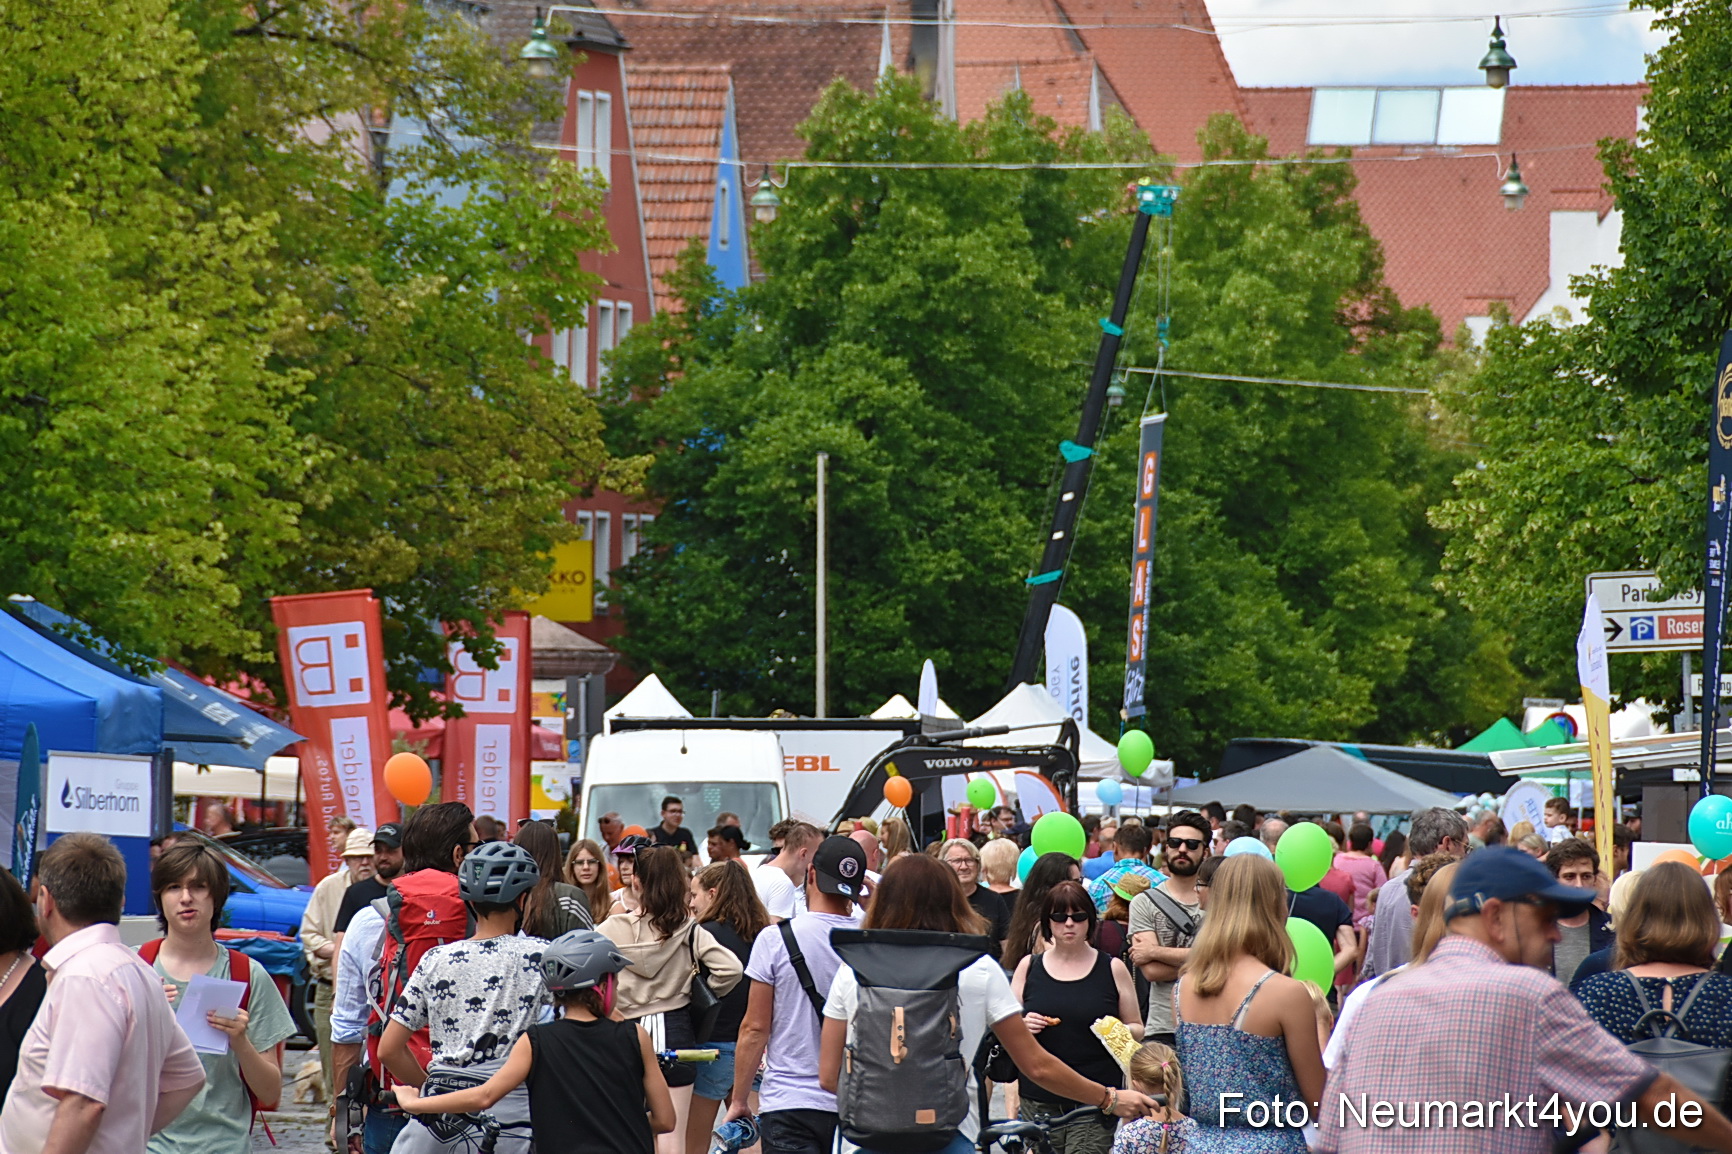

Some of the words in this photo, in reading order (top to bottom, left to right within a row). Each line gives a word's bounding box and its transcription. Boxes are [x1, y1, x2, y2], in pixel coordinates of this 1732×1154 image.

[1132, 457, 1155, 656] GLAS
[923, 757, 973, 769] VOLVO
[75, 786, 140, 812] Silberhorn
